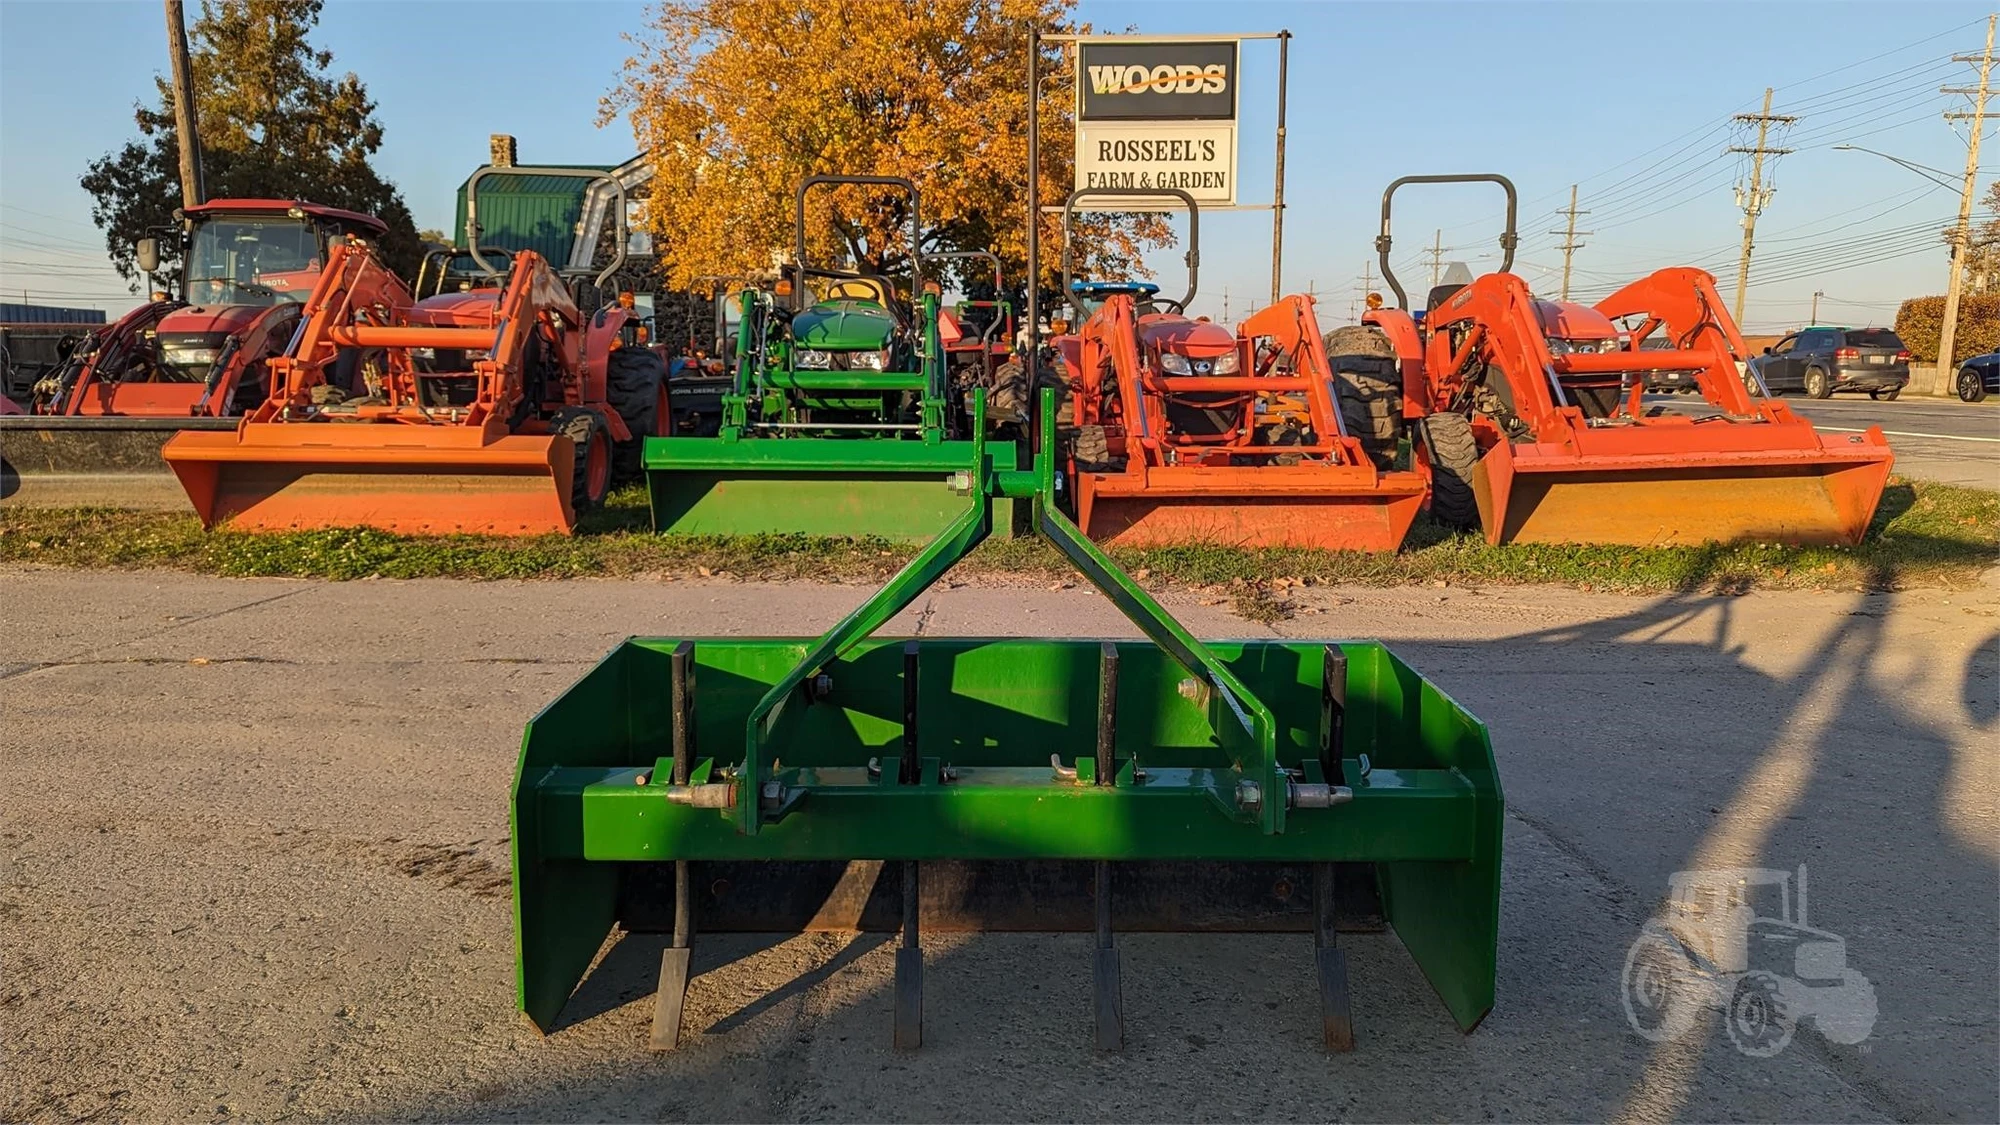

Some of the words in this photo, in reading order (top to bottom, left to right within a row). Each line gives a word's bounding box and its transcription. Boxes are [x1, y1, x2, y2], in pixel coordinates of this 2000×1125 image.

[1088, 64, 1226, 94] WOODS
[1098, 139, 1215, 162] ROSSEEL'S
[1087, 171, 1135, 189] FARM
[1139, 172, 1152, 189] &
[1156, 171, 1226, 189] GARDEN
